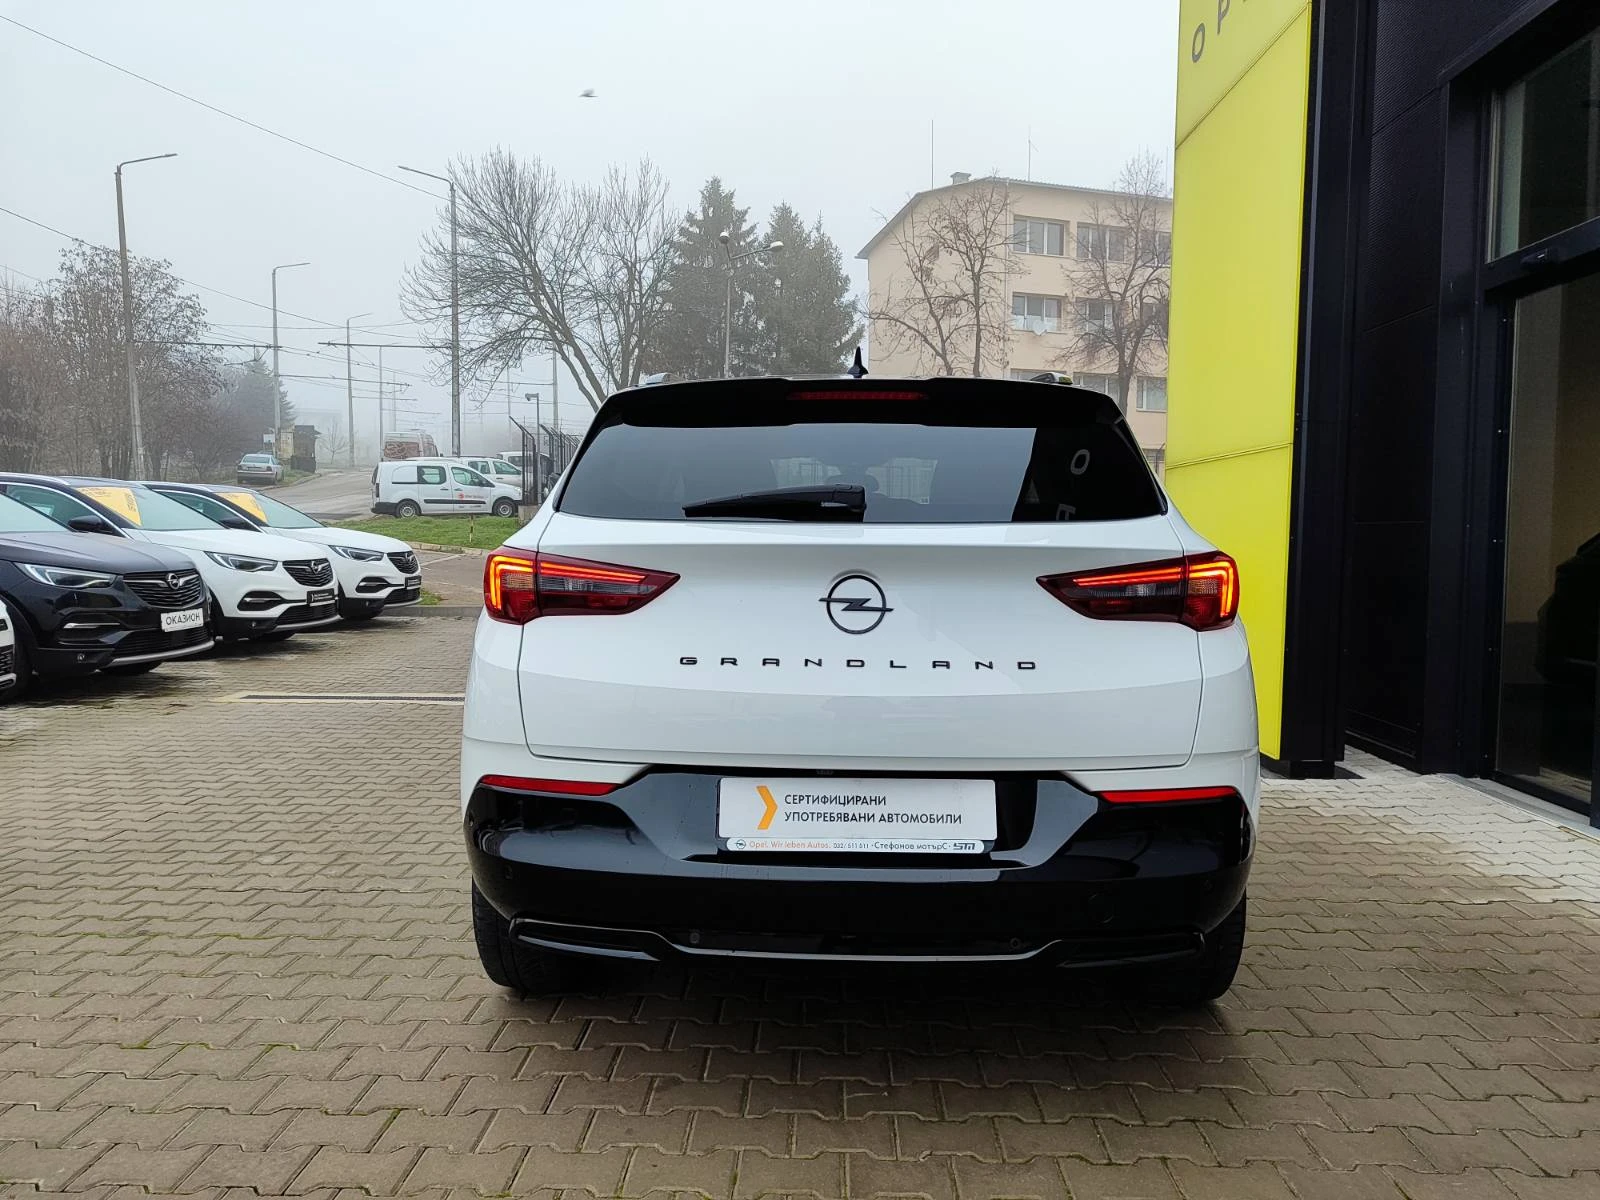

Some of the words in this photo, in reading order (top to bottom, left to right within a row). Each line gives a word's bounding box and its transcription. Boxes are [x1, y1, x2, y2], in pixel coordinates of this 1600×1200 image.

[165, 612, 201, 626] ОКАЗИОН
[679, 656, 1037, 671] GRANDLAND
[784, 793, 887, 807] СЕРТИФИЦИРАНИ
[784, 811, 876, 823] УПОТРЕБЯВАНИ
[878, 812, 962, 825] АВТОМОБИЛИ
